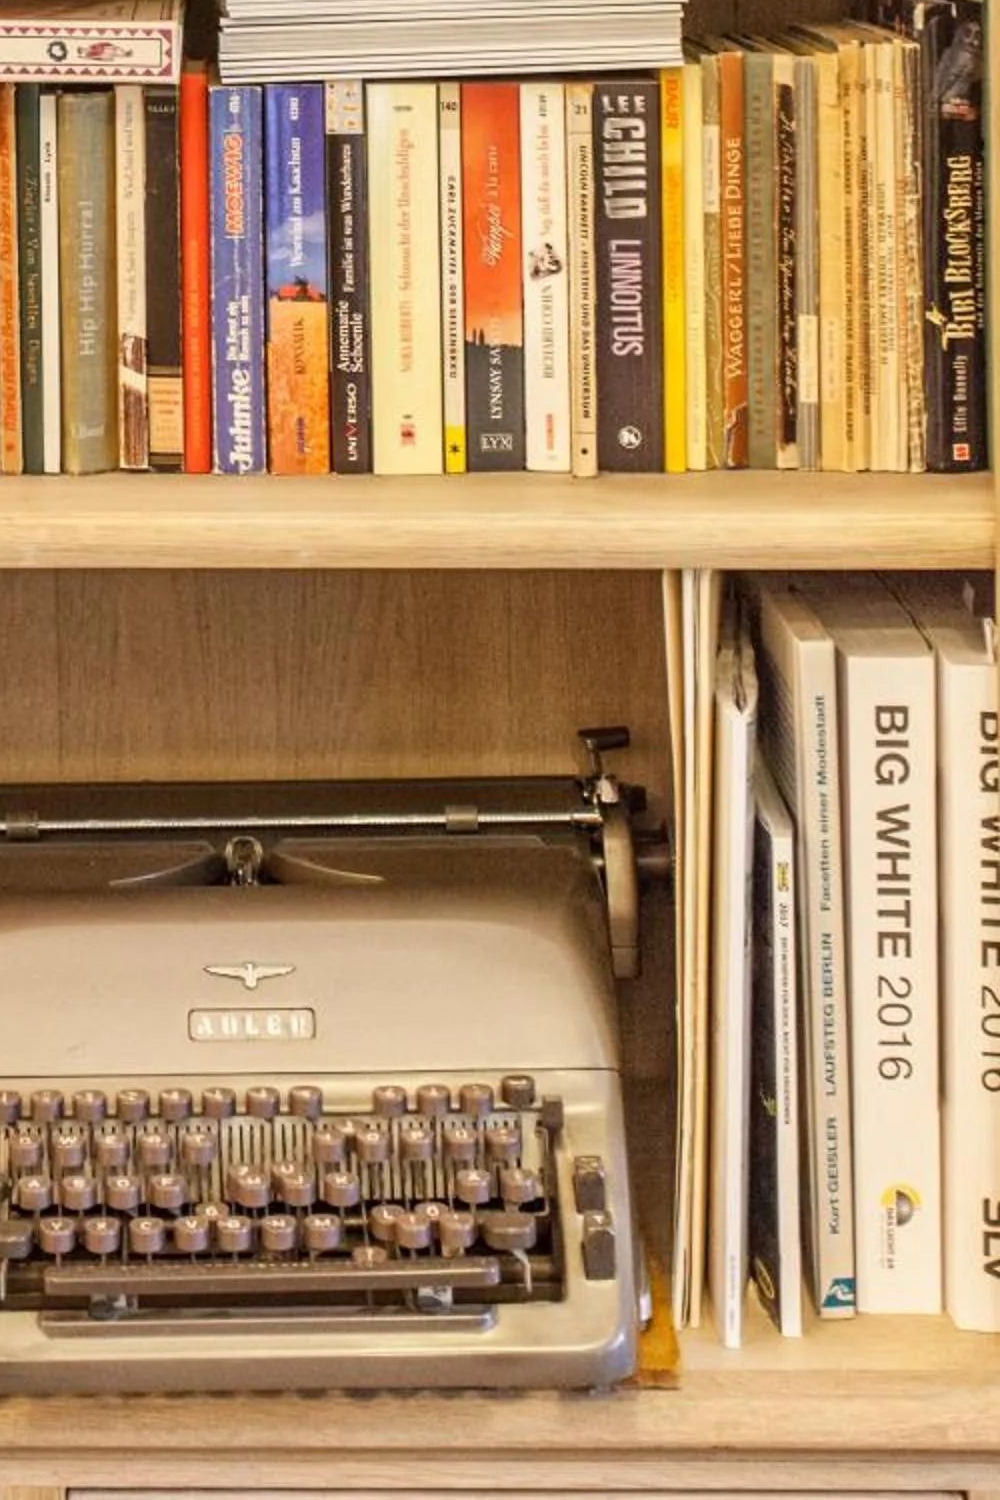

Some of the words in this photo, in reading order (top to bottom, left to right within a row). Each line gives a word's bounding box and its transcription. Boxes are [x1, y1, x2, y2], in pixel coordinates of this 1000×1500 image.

[221, 133, 243, 236] MOEWIG
[339, 143, 354, 213] Wunderbares
[602, 117, 649, 219] CHILD
[724, 138, 742, 200] DINGE
[725, 204, 742, 260] LIEBE
[943, 155, 975, 284] BLOCKSBERG
[77, 256, 96, 292] Hip
[341, 252, 356, 293] Familie
[608, 239, 645, 357] LINNOITUS
[79, 300, 99, 336] Hip
[334, 300, 352, 373] Annemarie
[348, 312, 366, 373] Schoenle
[725, 277, 744, 378] WAGGERL
[945, 289, 976, 341] BIBI
[224, 369, 257, 472] Juhnke
[344, 383, 358, 461] UNIVERSO
[486, 366, 503, 420] LYNSAY
[814, 695, 831, 785] Modestadt
[875, 704, 912, 786] BIG
[818, 795, 831, 839] einer
[818, 850, 833, 917] Facetten
[876, 803, 912, 959] WHITE
[821, 938, 836, 999] BERLIN
[195, 1013, 309, 1037] ADLER
[822, 1003, 837, 1097] LAUFSTEG
[876, 975, 914, 1082] 2016
